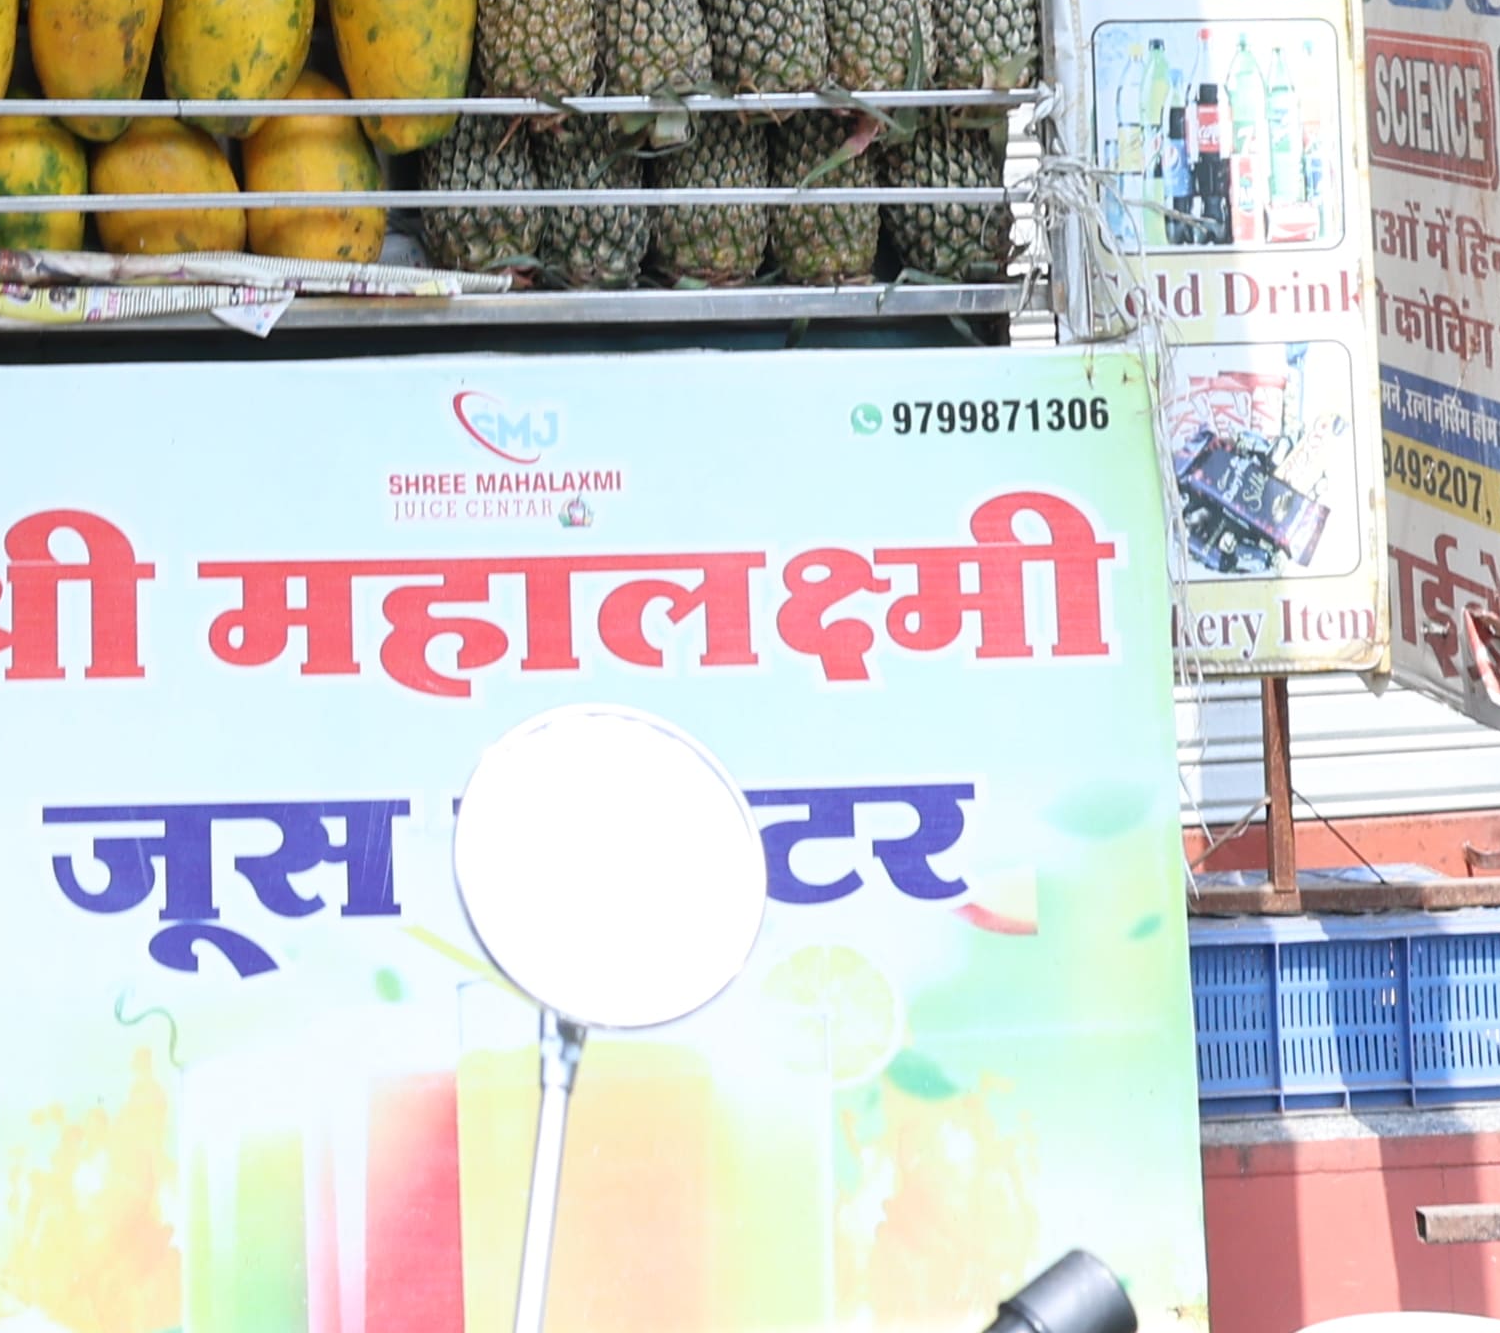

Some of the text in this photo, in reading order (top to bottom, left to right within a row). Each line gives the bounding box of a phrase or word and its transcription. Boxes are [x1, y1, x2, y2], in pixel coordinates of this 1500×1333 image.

[1373, 52, 1486, 163] SCIENCE
[468, 408, 559, 449] SMJ
[890, 396, 1111, 435] 9799871306
[389, 468, 623, 496] SHREE MAHALAXMI
[393, 496, 555, 521] JUICE CENTAR
[197, 489, 1118, 698] महालक्ष्मी
[1171, 603, 1264, 661] kery
[41, 796, 411, 981] जूस
